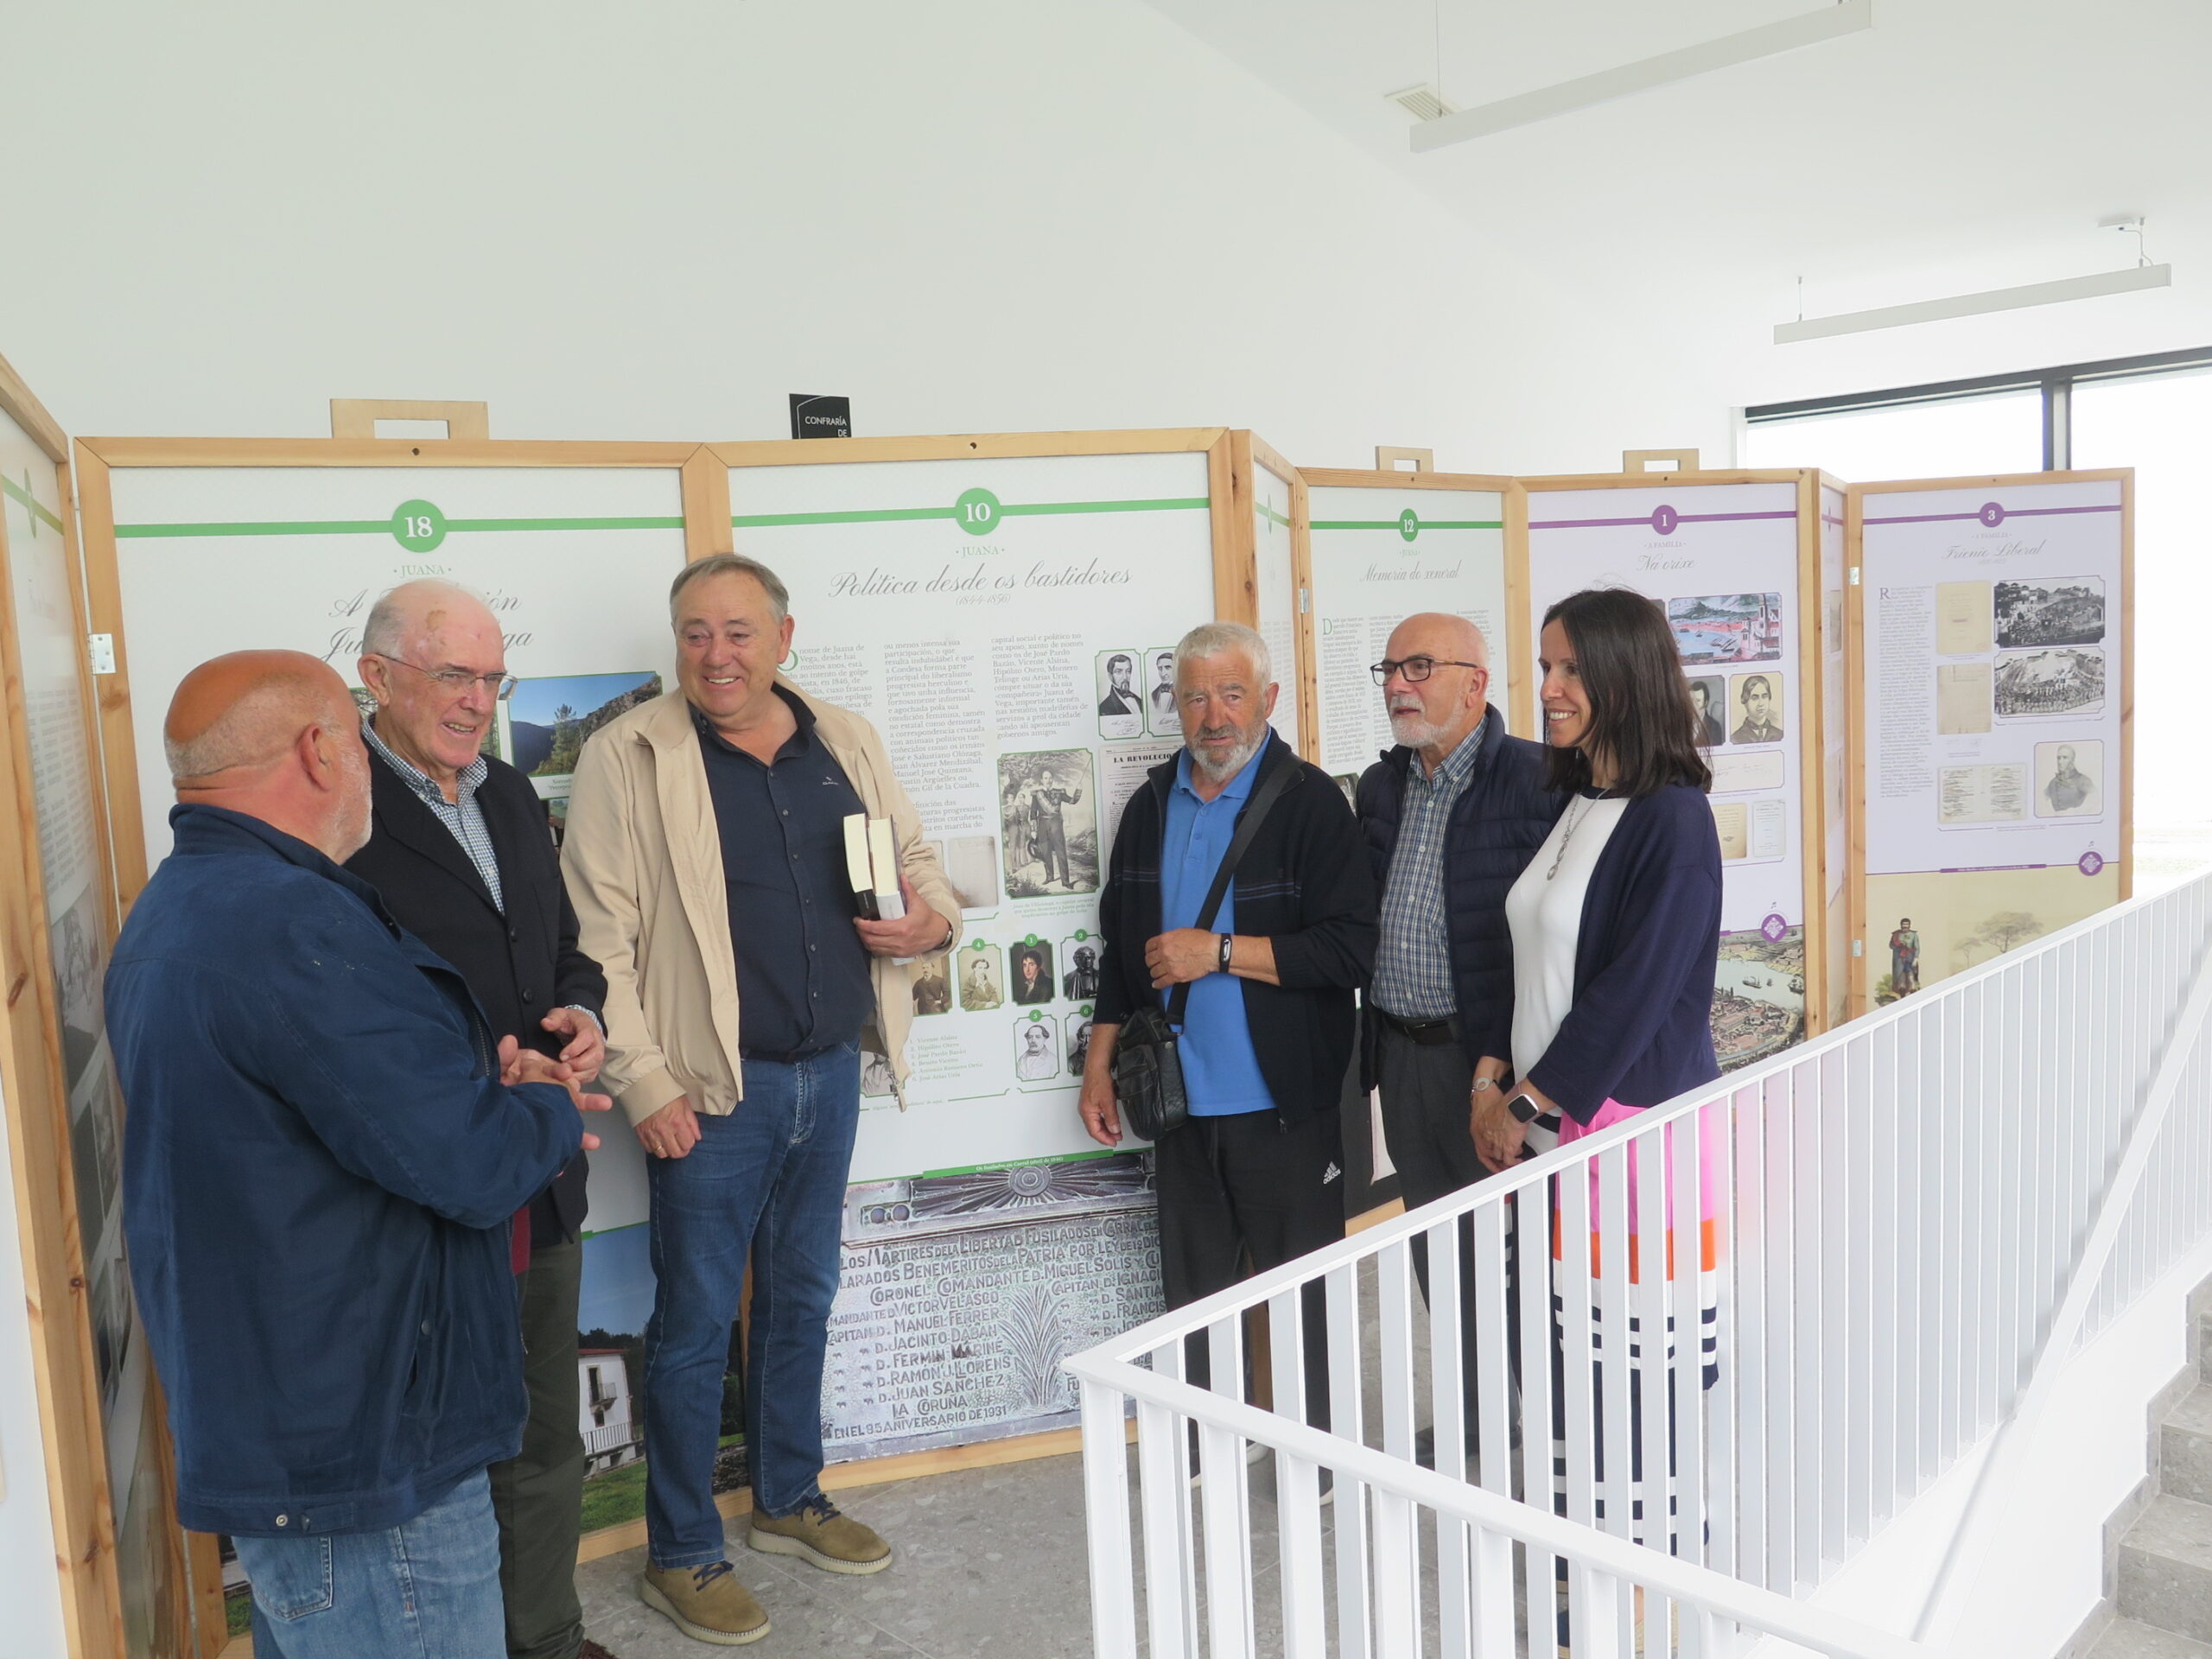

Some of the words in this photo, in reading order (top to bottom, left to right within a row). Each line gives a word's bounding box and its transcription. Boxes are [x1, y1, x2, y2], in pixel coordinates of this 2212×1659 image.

[805, 415, 847, 426] CONFRARÍA
[965, 502, 992, 522] 10
[1661, 514, 1668, 527] 1
[1987, 509, 1996, 521] 3
[404, 516, 433, 538] 18
[1403, 519, 1414, 532] 12
[961, 546, 999, 559] JUANA
[1993, 539, 2047, 557] Liberal
[400, 564, 445, 578] JUANA
[1359, 563, 1407, 582] Memoria
[1409, 561, 1421, 581] do
[1424, 559, 1462, 580] xeneral
[1637, 553, 1663, 571] Na
[1662, 557, 1695, 569] orixe
[828, 567, 919, 597] Política
[925, 563, 988, 593] desde
[995, 574, 1016, 589] os
[1024, 557, 1134, 589] bastidores
[328, 588, 368, 618] A
[956, 594, 1011, 607] (1844-1856)
[1127, 753, 1171, 762] REVOLUCIO
[1323, 1169, 1341, 1184] adidas
[841, 1255, 865, 1271] LOS
[960, 1235, 1023, 1254] LIBERTAD
[1026, 1227, 1090, 1245] FUSILADOS
[904, 1256, 993, 1280] BENEMERITOS
[1018, 1247, 1065, 1265] PATRIA
[1070, 1244, 1095, 1258] POR
[1098, 1241, 1118, 1255] LEY
[870, 1285, 932, 1306] CORONEL
[938, 1269, 1031, 1297] COMANDANTE
[1045, 1262, 1093, 1279] MIGUEL
[1094, 1257, 1132, 1272] SOLIS
[1052, 1281, 1099, 1296] CAPITAN
[1117, 1268, 1161, 1286] IGNACI
[1116, 1286, 1164, 1301] SANTIA
[826, 1309, 885, 1327] MANDANTE
[939, 1291, 999, 1311] VELASCO
[1117, 1300, 1166, 1318] FRANCIS
[894, 1312, 947, 1334] MANUEL
[948, 1308, 999, 1326] FERRER
[888, 1332, 947, 1351] JACINTO
[955, 1356, 1011, 1379] LLORENS
[894, 1385, 928, 1402] JUAN
[933, 1374, 1004, 1395] SANCHEZ
[892, 1403, 909, 1419] LA
[917, 1395, 968, 1415] CORUÑA
[850, 1424, 864, 1437] EL
[883, 1411, 966, 1432] ANIVERSARIO
[969, 1409, 983, 1421] DE
[984, 1405, 1007, 1418] 1931
